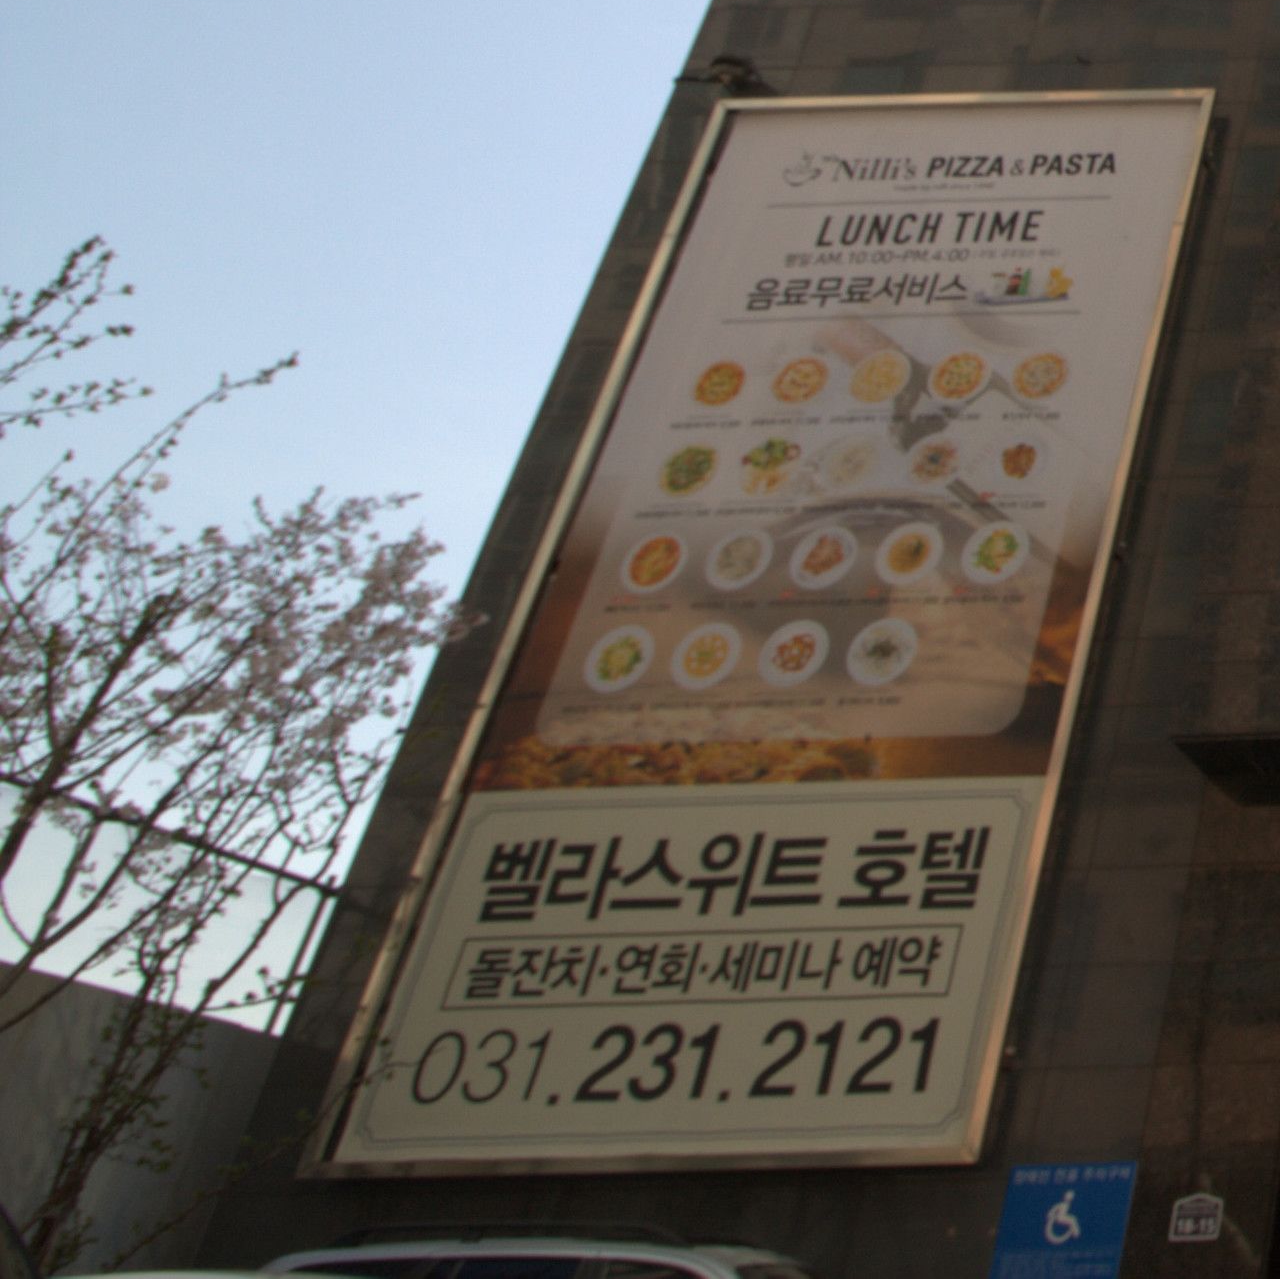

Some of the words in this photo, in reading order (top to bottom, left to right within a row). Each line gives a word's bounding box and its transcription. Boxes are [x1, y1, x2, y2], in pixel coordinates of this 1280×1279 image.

[926, 156, 1003, 178] PIZZA
[1029, 152, 1116, 175] PASTA
[815, 212, 943, 247] LUNCH
[955, 209, 1045, 242] TIME
[745, 272, 968, 312] 음료무료서비스
[478, 830, 830, 924] 벨라스위트
[837, 825, 992, 913] 호텔
[850, 934, 944, 991] 예약
[411, 1016, 945, 1106] 031.231.2121
